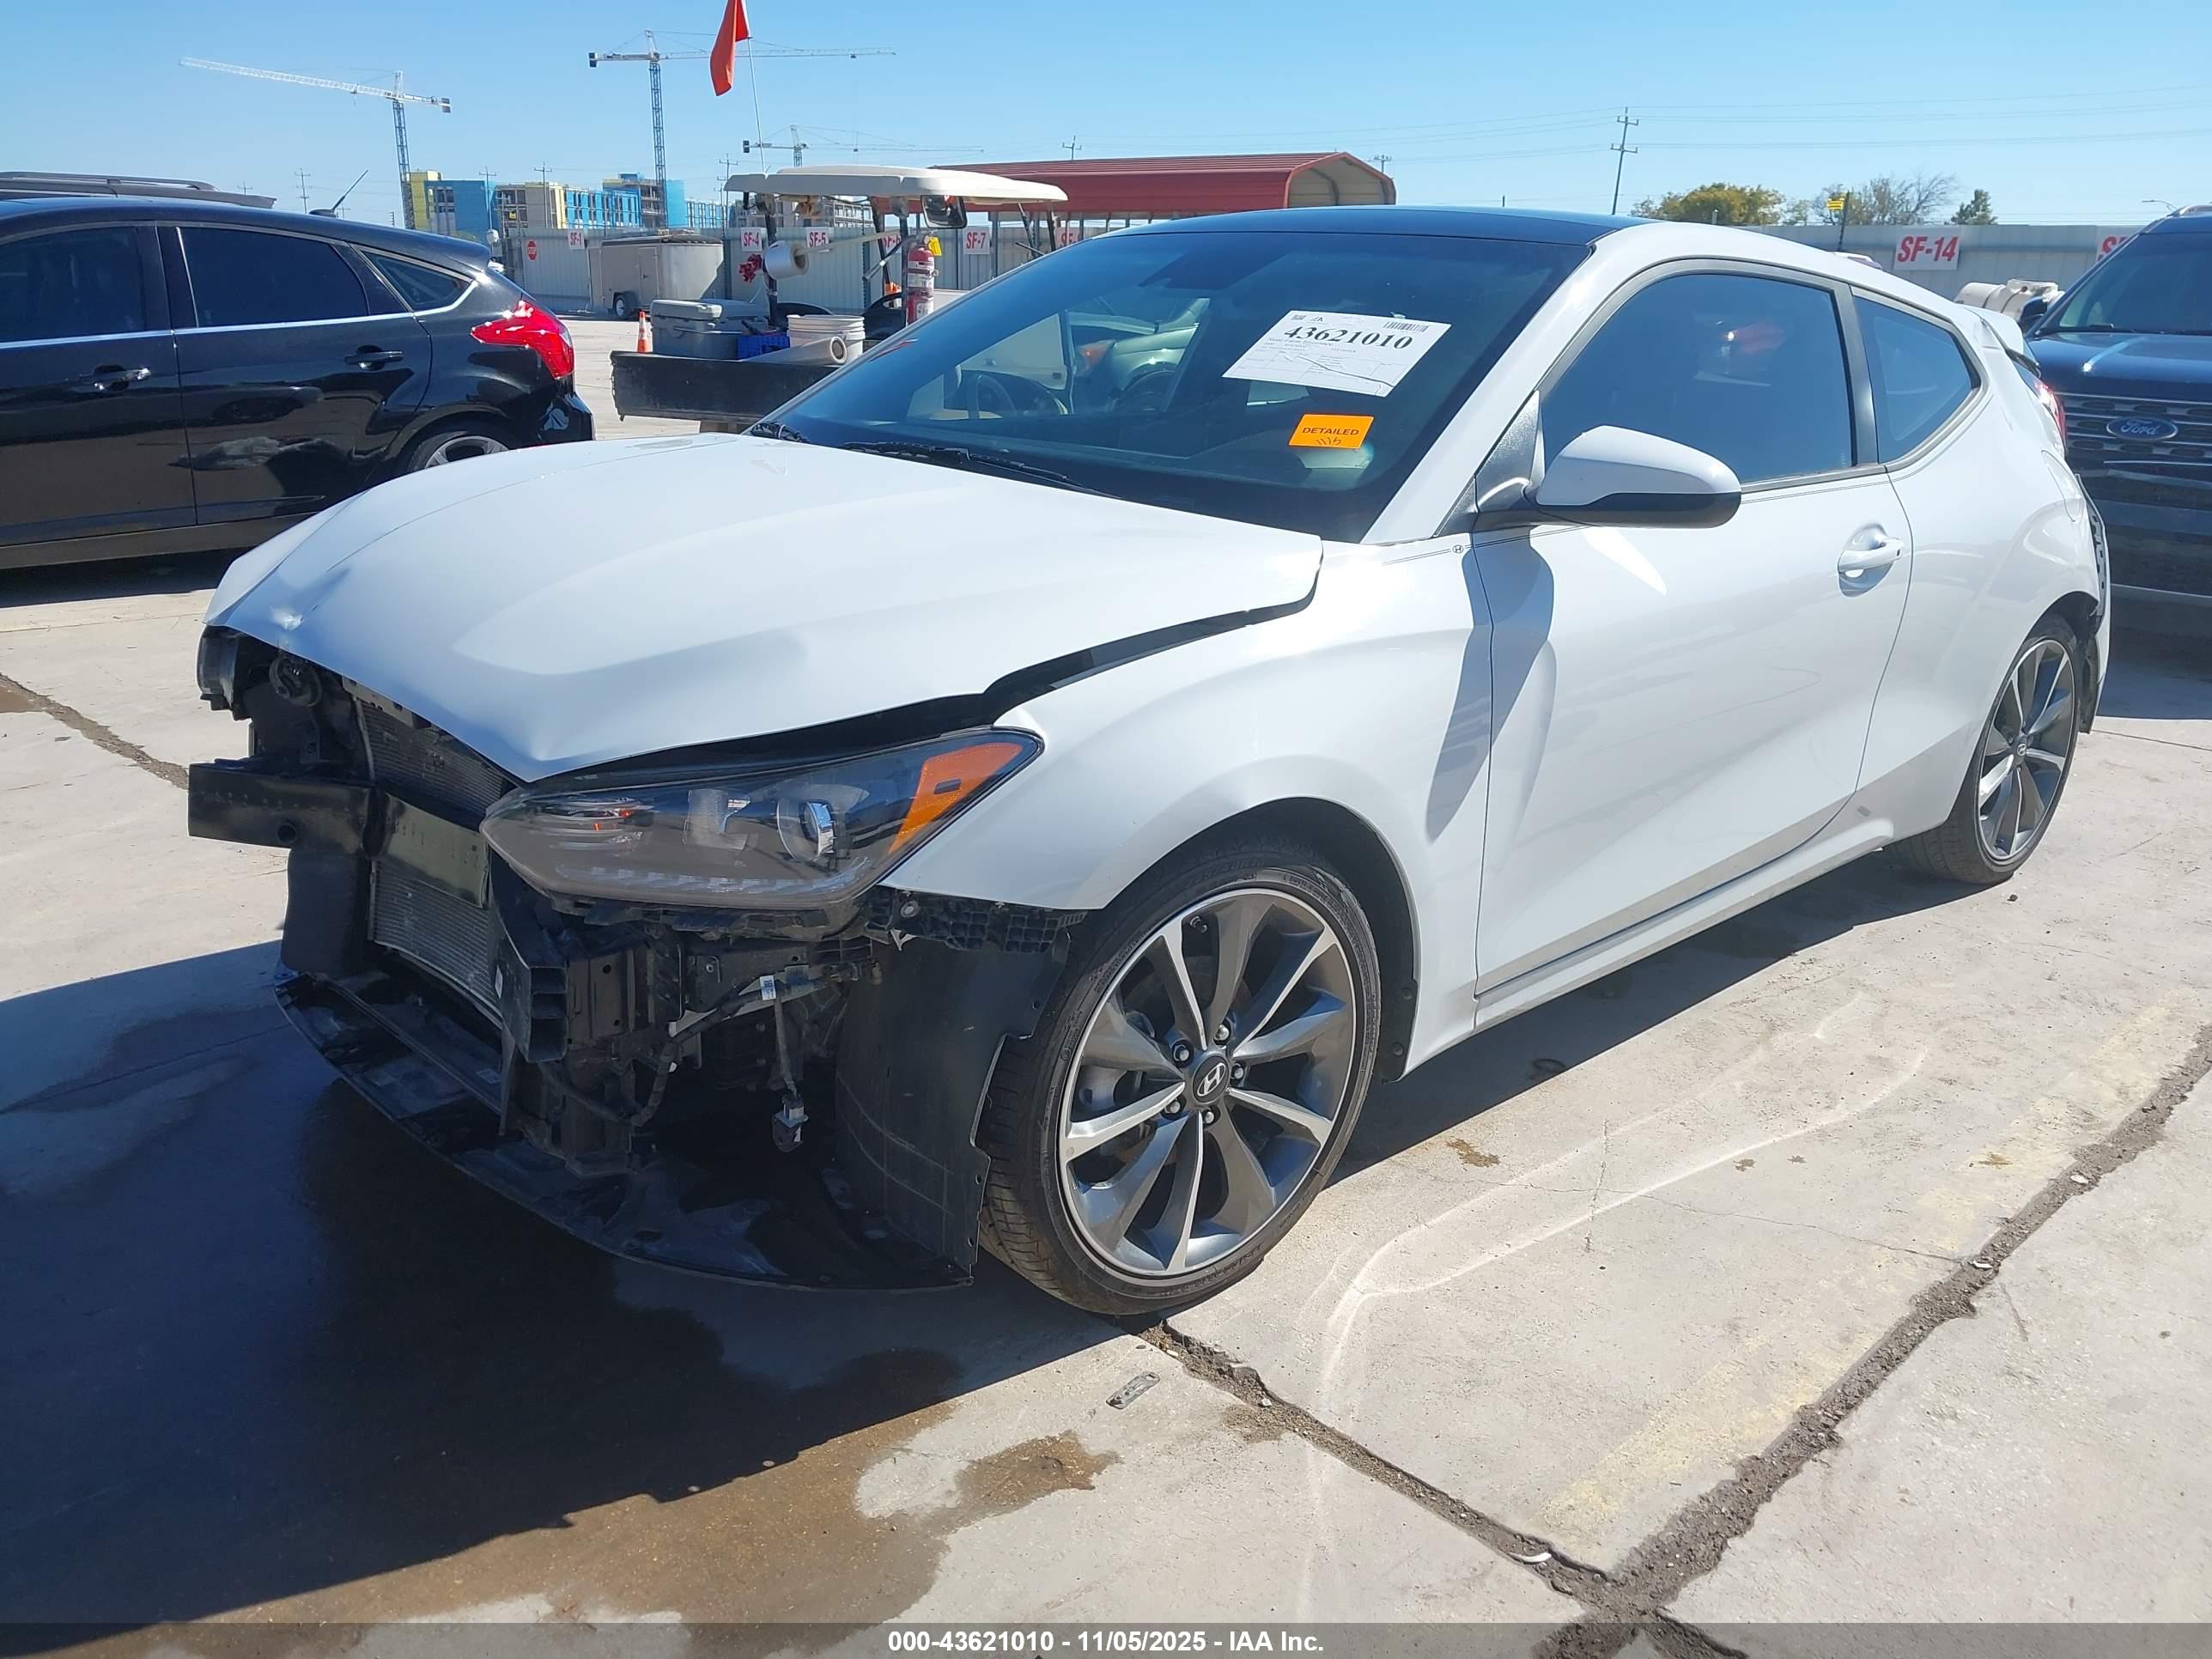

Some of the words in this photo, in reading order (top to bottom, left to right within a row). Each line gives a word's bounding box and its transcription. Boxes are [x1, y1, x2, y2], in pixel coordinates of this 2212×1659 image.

[570, 232, 582, 246] SF-1
[744, 232, 759, 246] SF-4
[809, 232, 826, 246] SF-5
[966, 232, 986, 249] SF-7
[1897, 236, 1959, 262] SF-14
[1284, 325, 1413, 349] 43621010
[1302, 427, 1359, 435] DETAILED
[2121, 419, 2160, 434] Ford
